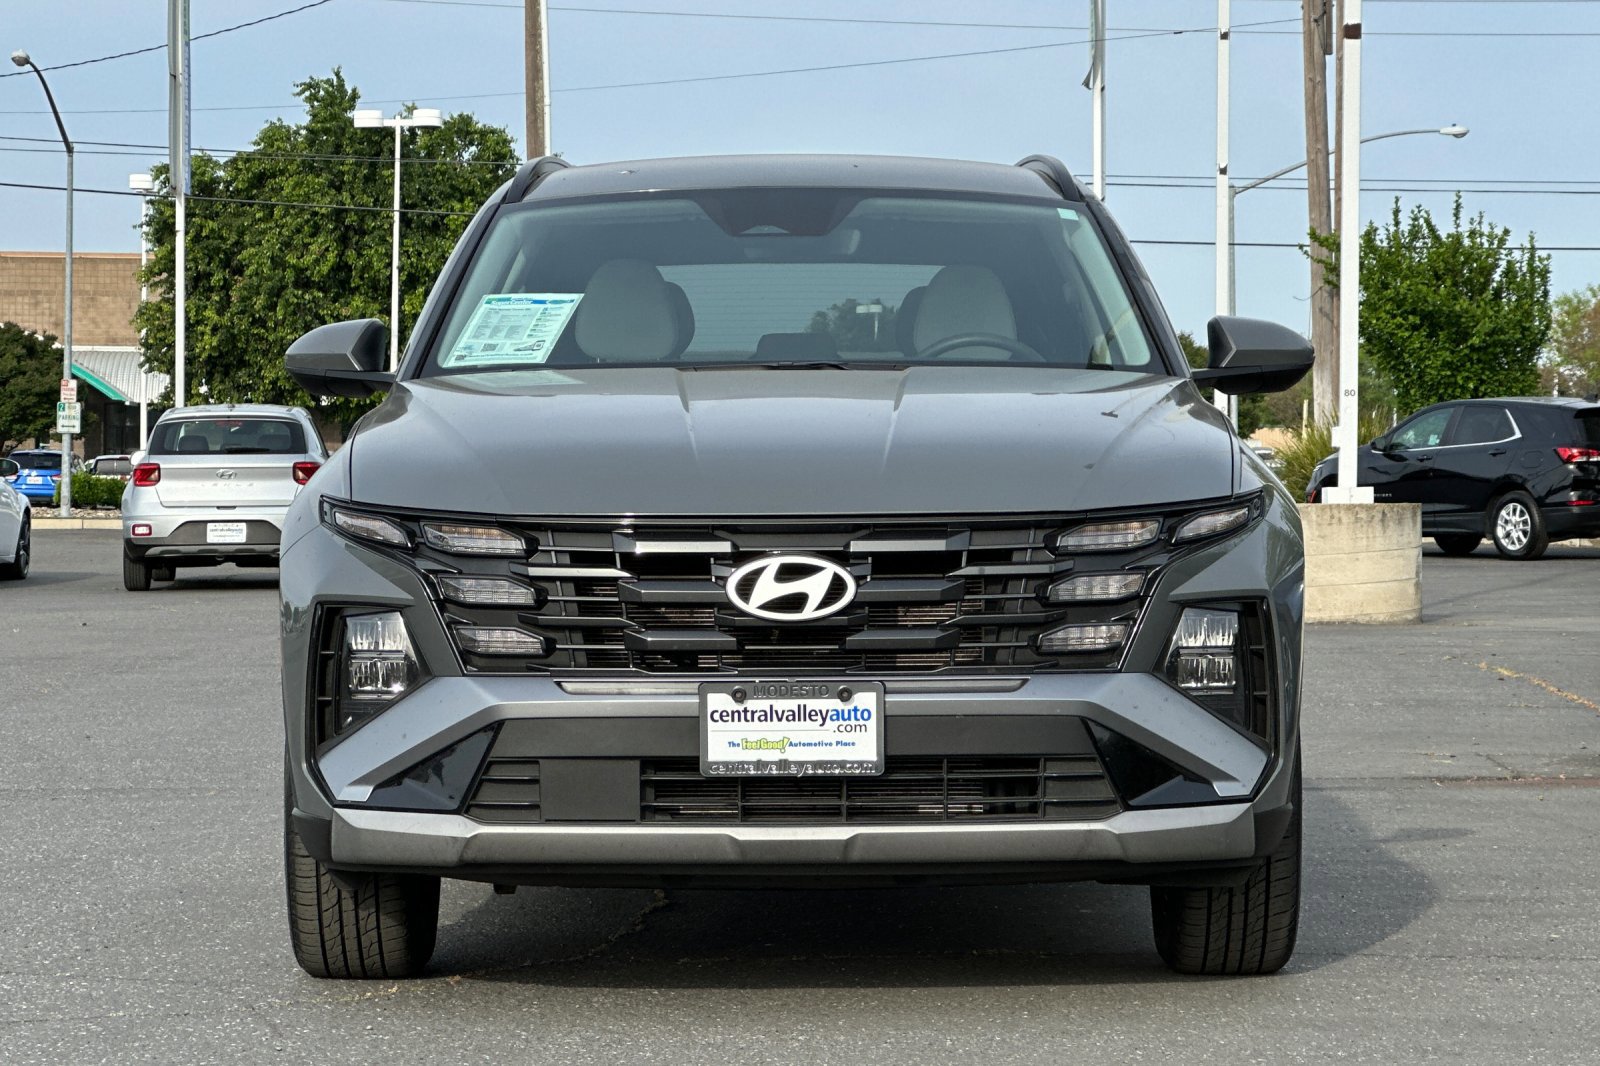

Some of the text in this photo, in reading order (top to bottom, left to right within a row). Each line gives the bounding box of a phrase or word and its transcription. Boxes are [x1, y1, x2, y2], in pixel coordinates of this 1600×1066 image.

[753, 684, 830, 698] MODESTO
[709, 704, 872, 727] centralvalleyauto
[833, 723, 868, 733] .com
[788, 740, 833, 748] Automotive
[709, 758, 876, 777] centralvalleyauto.com
